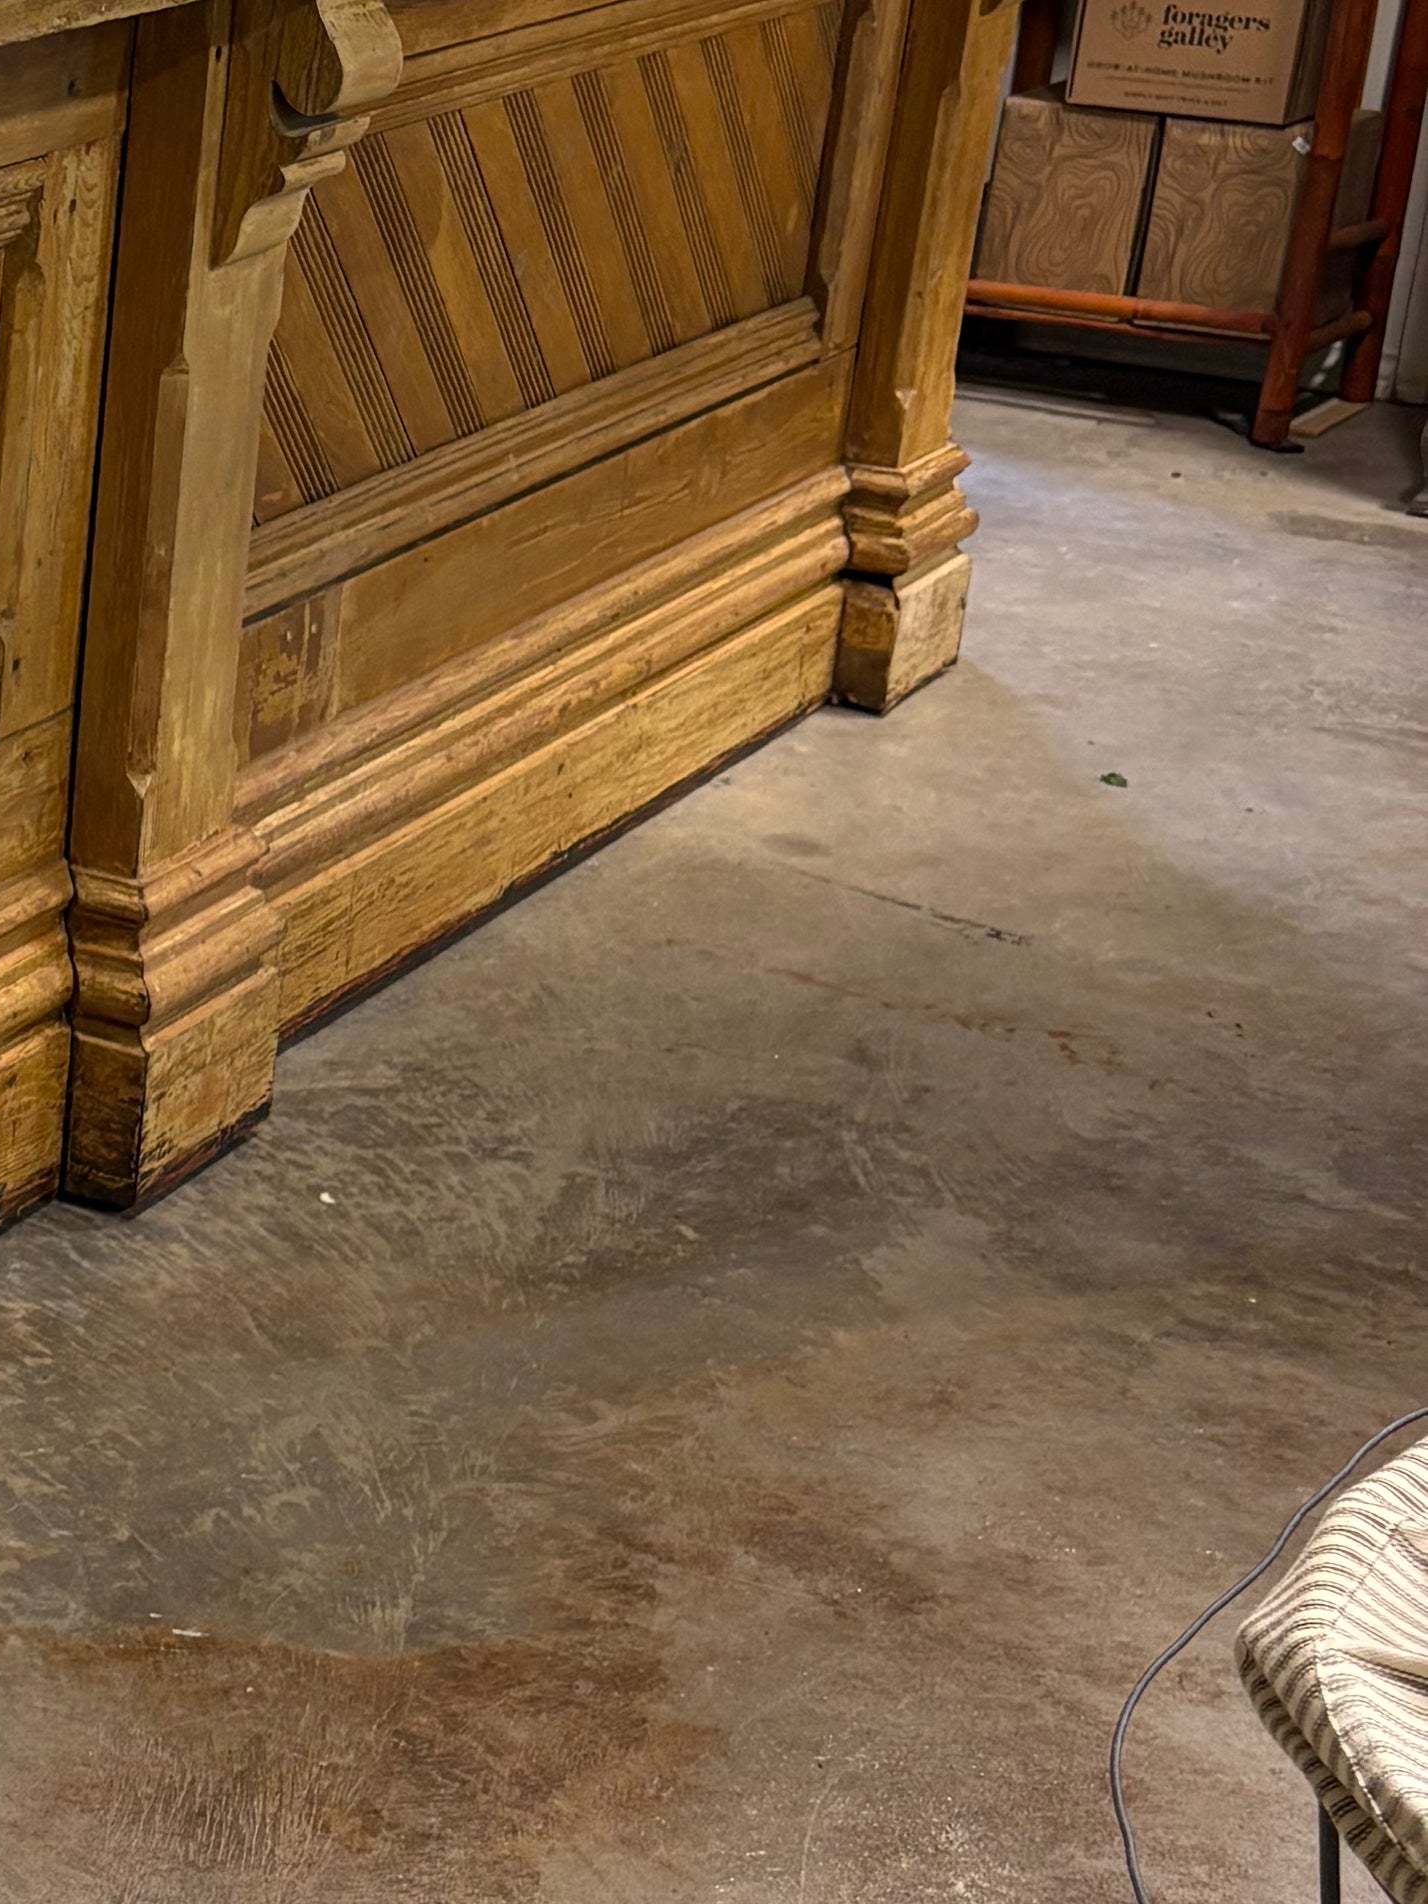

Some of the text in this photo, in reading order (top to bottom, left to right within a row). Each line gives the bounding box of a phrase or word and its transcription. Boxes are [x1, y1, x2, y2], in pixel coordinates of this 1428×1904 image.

[1162, 3, 1271, 33] foragers
[1157, 25, 1234, 55] galley
[1181, 68, 1251, 85] MUSHROOM
